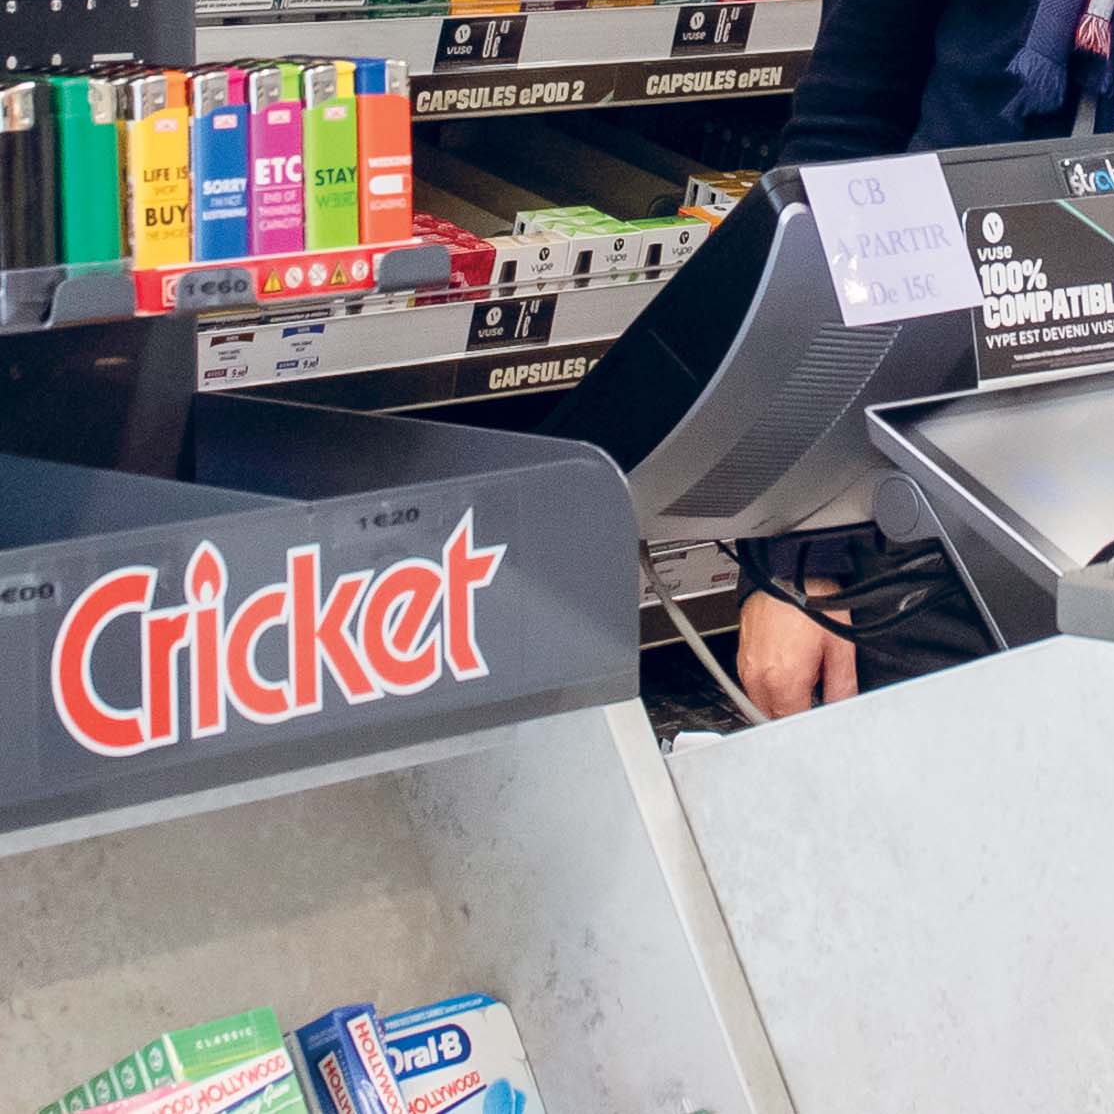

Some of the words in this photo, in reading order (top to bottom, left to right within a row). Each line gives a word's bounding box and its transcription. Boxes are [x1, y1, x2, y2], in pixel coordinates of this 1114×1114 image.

[682, 30, 706, 41] vuse
[446, 45, 473, 55] vuse
[646, 70, 735, 95] CAPSULES
[738, 67, 782, 87] ePEN
[416, 85, 515, 114] CAPSULES
[519, 83, 569, 104] ePOD
[573, 81, 585, 101] 2
[143, 168, 171, 183] LIFE
[176, 165, 188, 180] IS
[254, 155, 302, 186] ETC
[315, 166, 357, 187] STAY
[203, 178, 247, 195] SORRY
[847, 177, 886, 206] CB
[145, 204, 189, 228] BUY
[858, 223, 952, 259] PARTIR
[977, 245, 1013, 261] vuse
[979, 258, 1048, 296] 100%
[870, 281, 899, 306] De
[478, 327, 504, 338] vuse
[985, 329, 1018, 350] VYPE
[1020, 328, 1041, 344] EST
[1043, 322, 1090, 343] DEVENU
[489, 357, 586, 389] CAPSULES
[52, 506, 508, 758] Cricket
[195, 1027, 254, 1050] CLASSIC
[355, 1021, 404, 1114] HOLLYWOO
[197, 1054, 287, 1112] HOLLYWOOD
